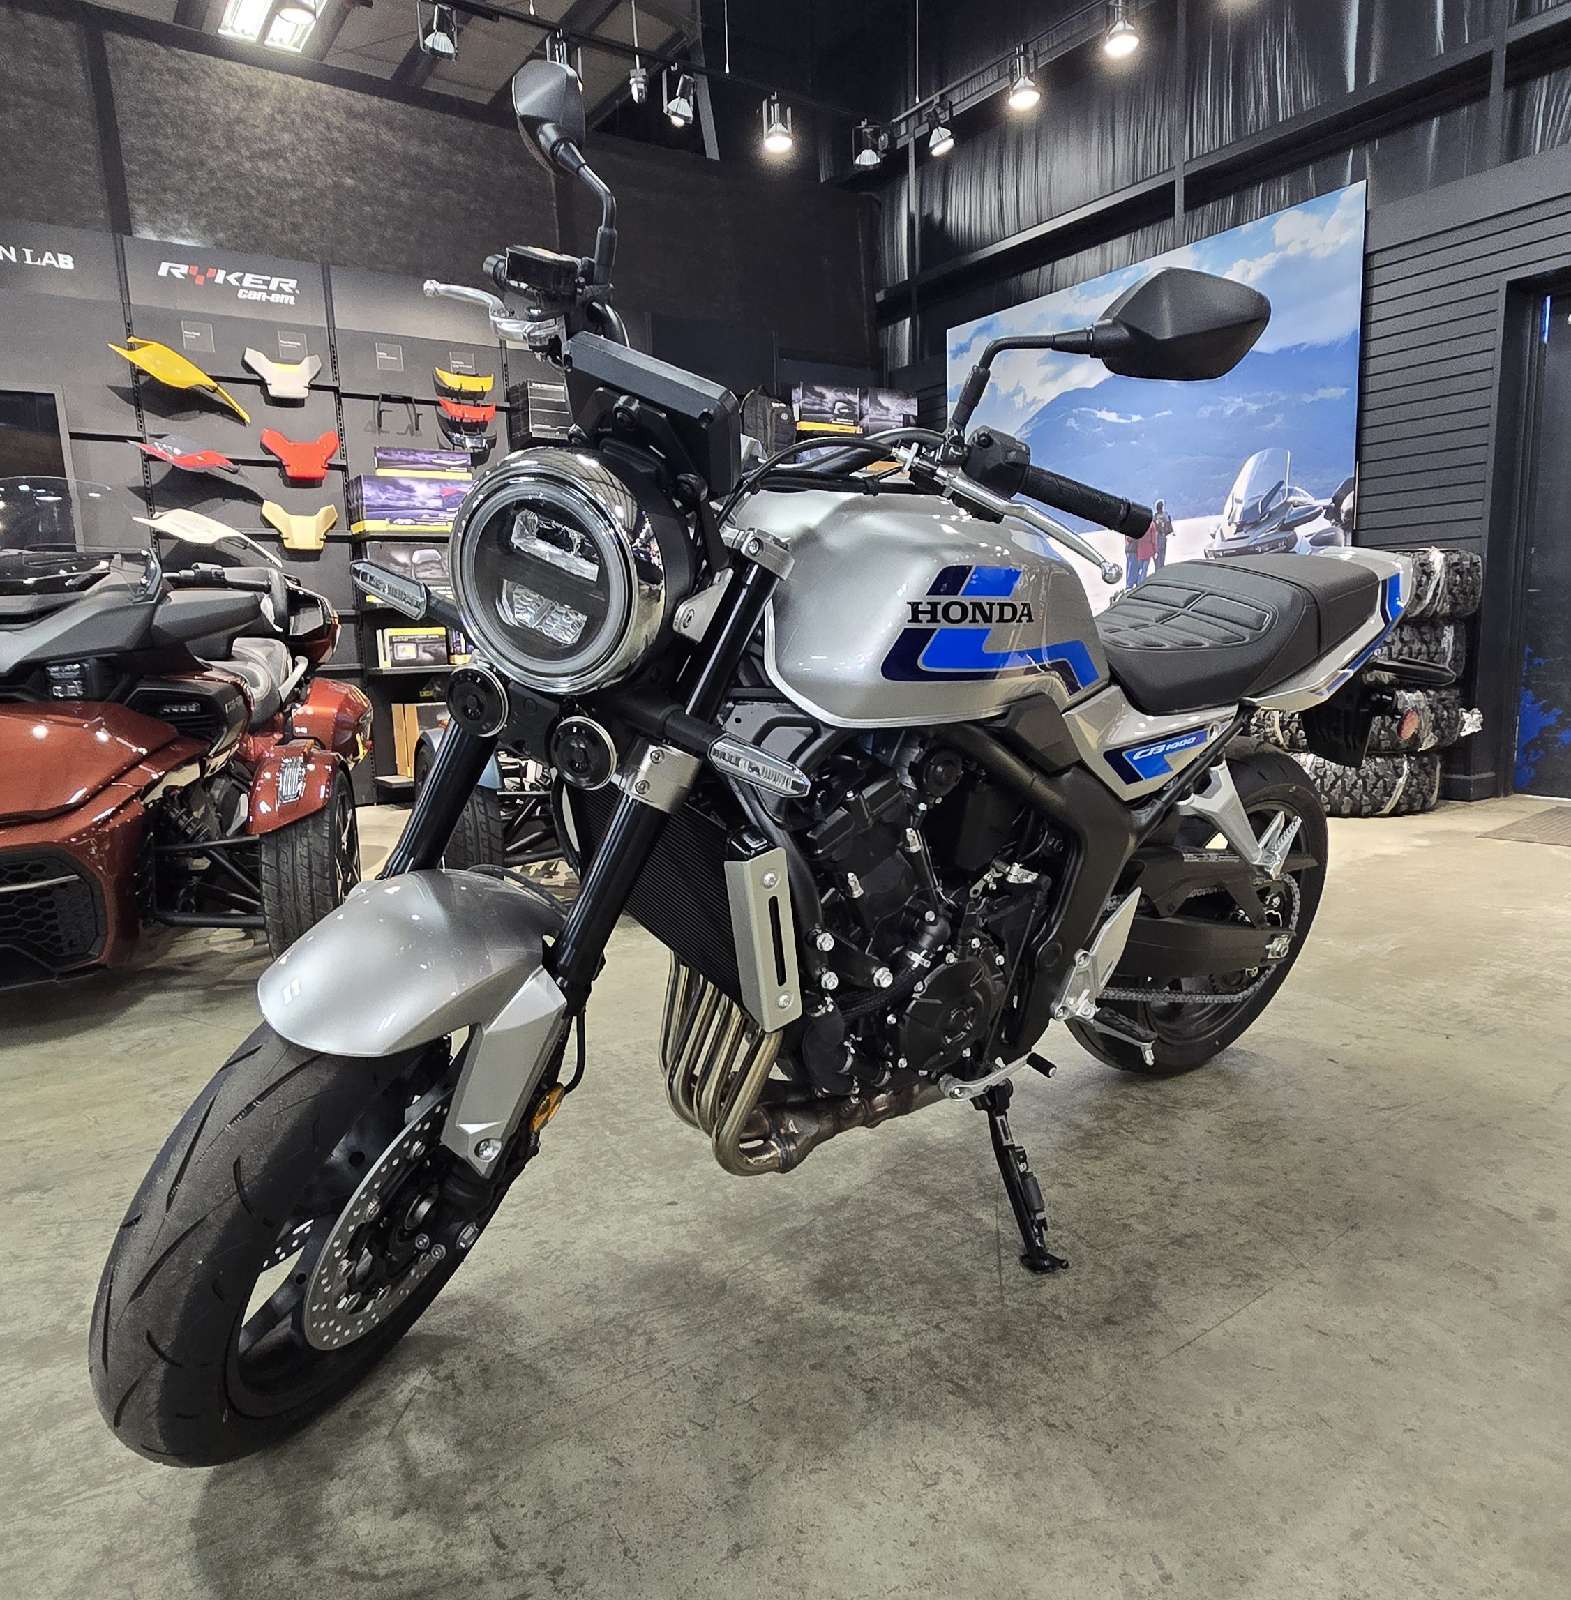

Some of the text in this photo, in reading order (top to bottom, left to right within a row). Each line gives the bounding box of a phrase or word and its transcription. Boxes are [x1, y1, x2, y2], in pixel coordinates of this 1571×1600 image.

[21, 247, 75, 270] LAB
[157, 261, 298, 294] RYKER
[906, 601, 1035, 624] HONDA
